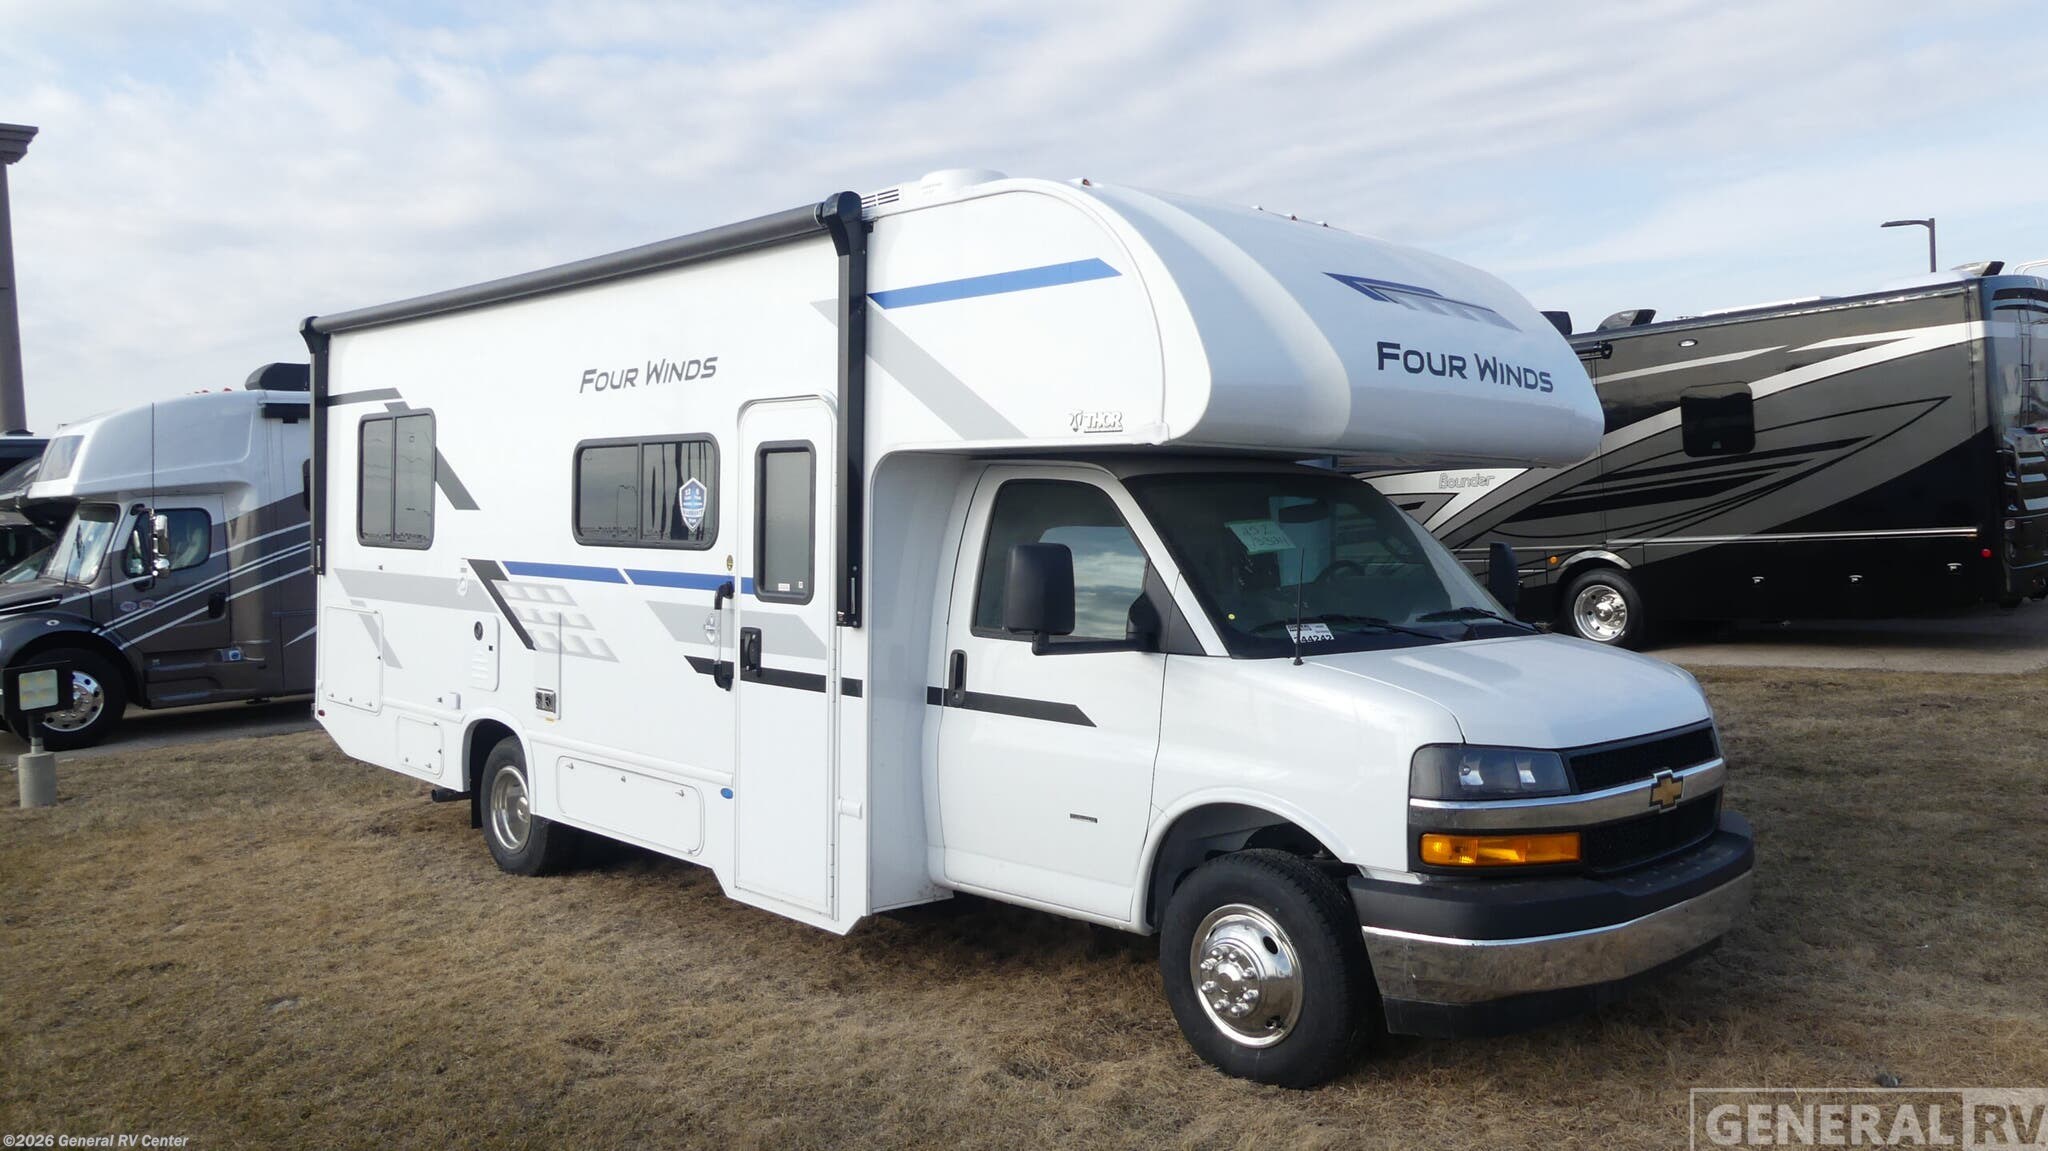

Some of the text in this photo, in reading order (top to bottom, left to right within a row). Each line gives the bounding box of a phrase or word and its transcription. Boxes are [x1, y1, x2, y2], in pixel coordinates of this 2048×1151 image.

[579, 356, 719, 394] FOUR WINDS
[1376, 341, 1554, 393] FOUR WINDS
[1083, 411, 1123, 430] THOR
[1439, 472, 1496, 489] Bounder
